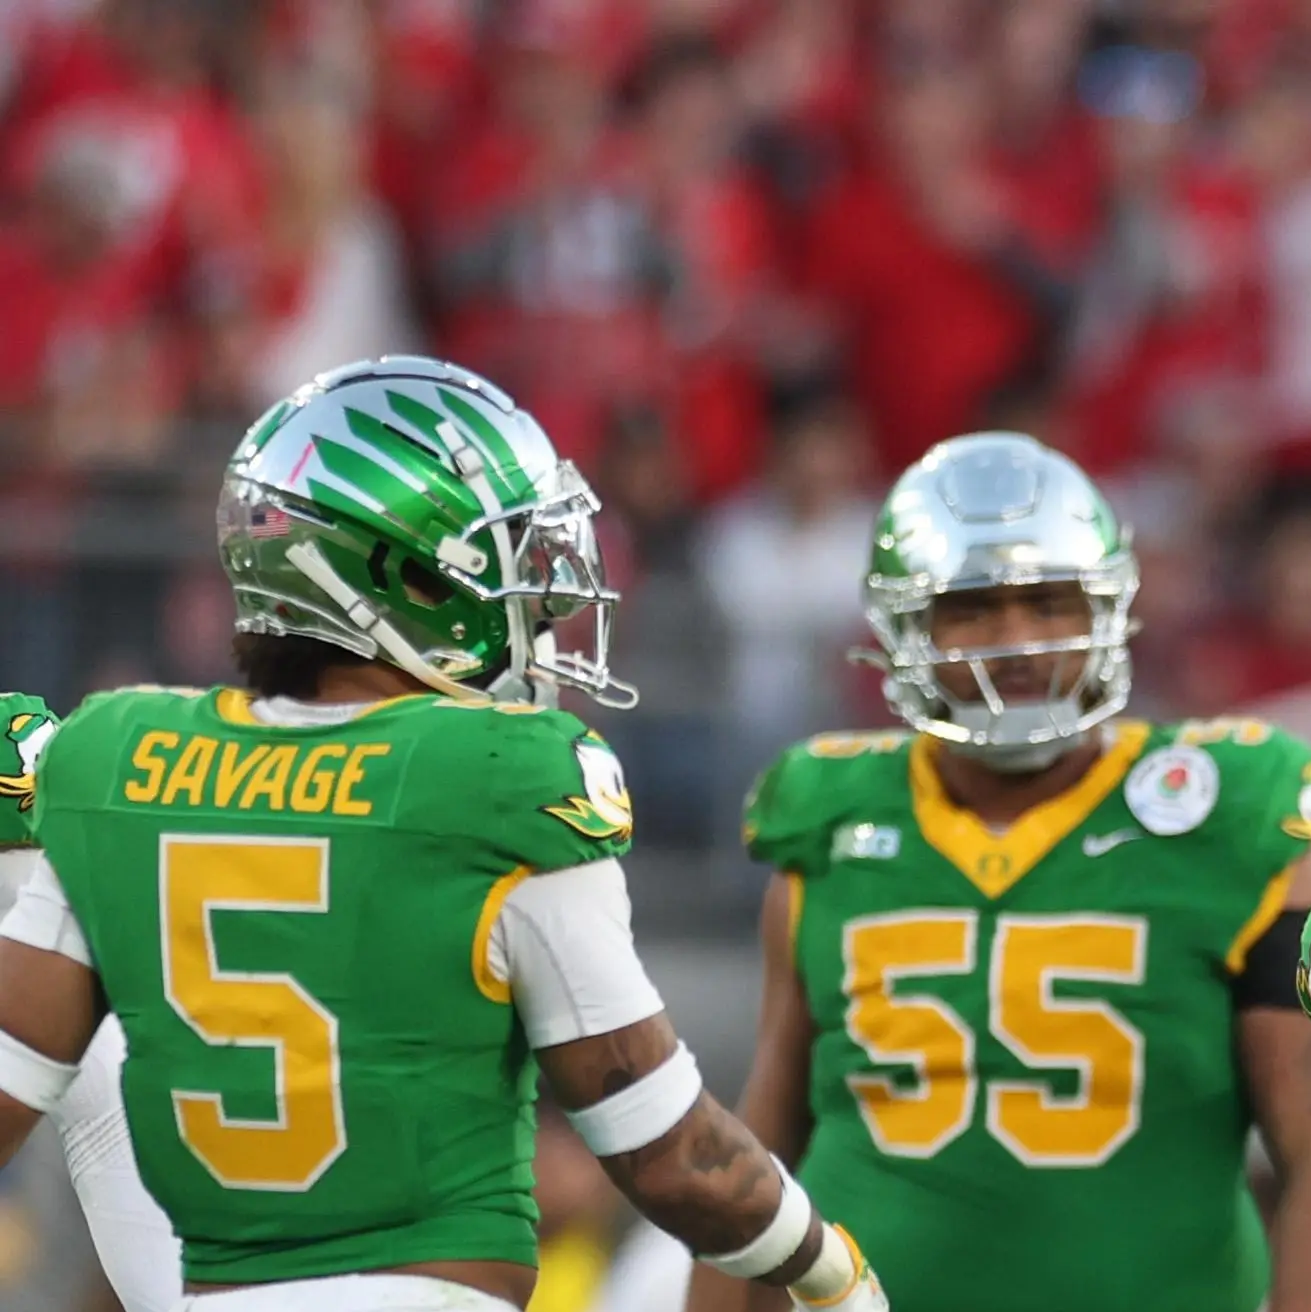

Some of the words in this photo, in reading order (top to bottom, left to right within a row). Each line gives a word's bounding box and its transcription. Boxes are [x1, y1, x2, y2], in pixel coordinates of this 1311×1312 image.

[125, 730, 391, 817] SAVAGE
[158, 832, 347, 1193] 5
[843, 907, 1149, 1169] 55
